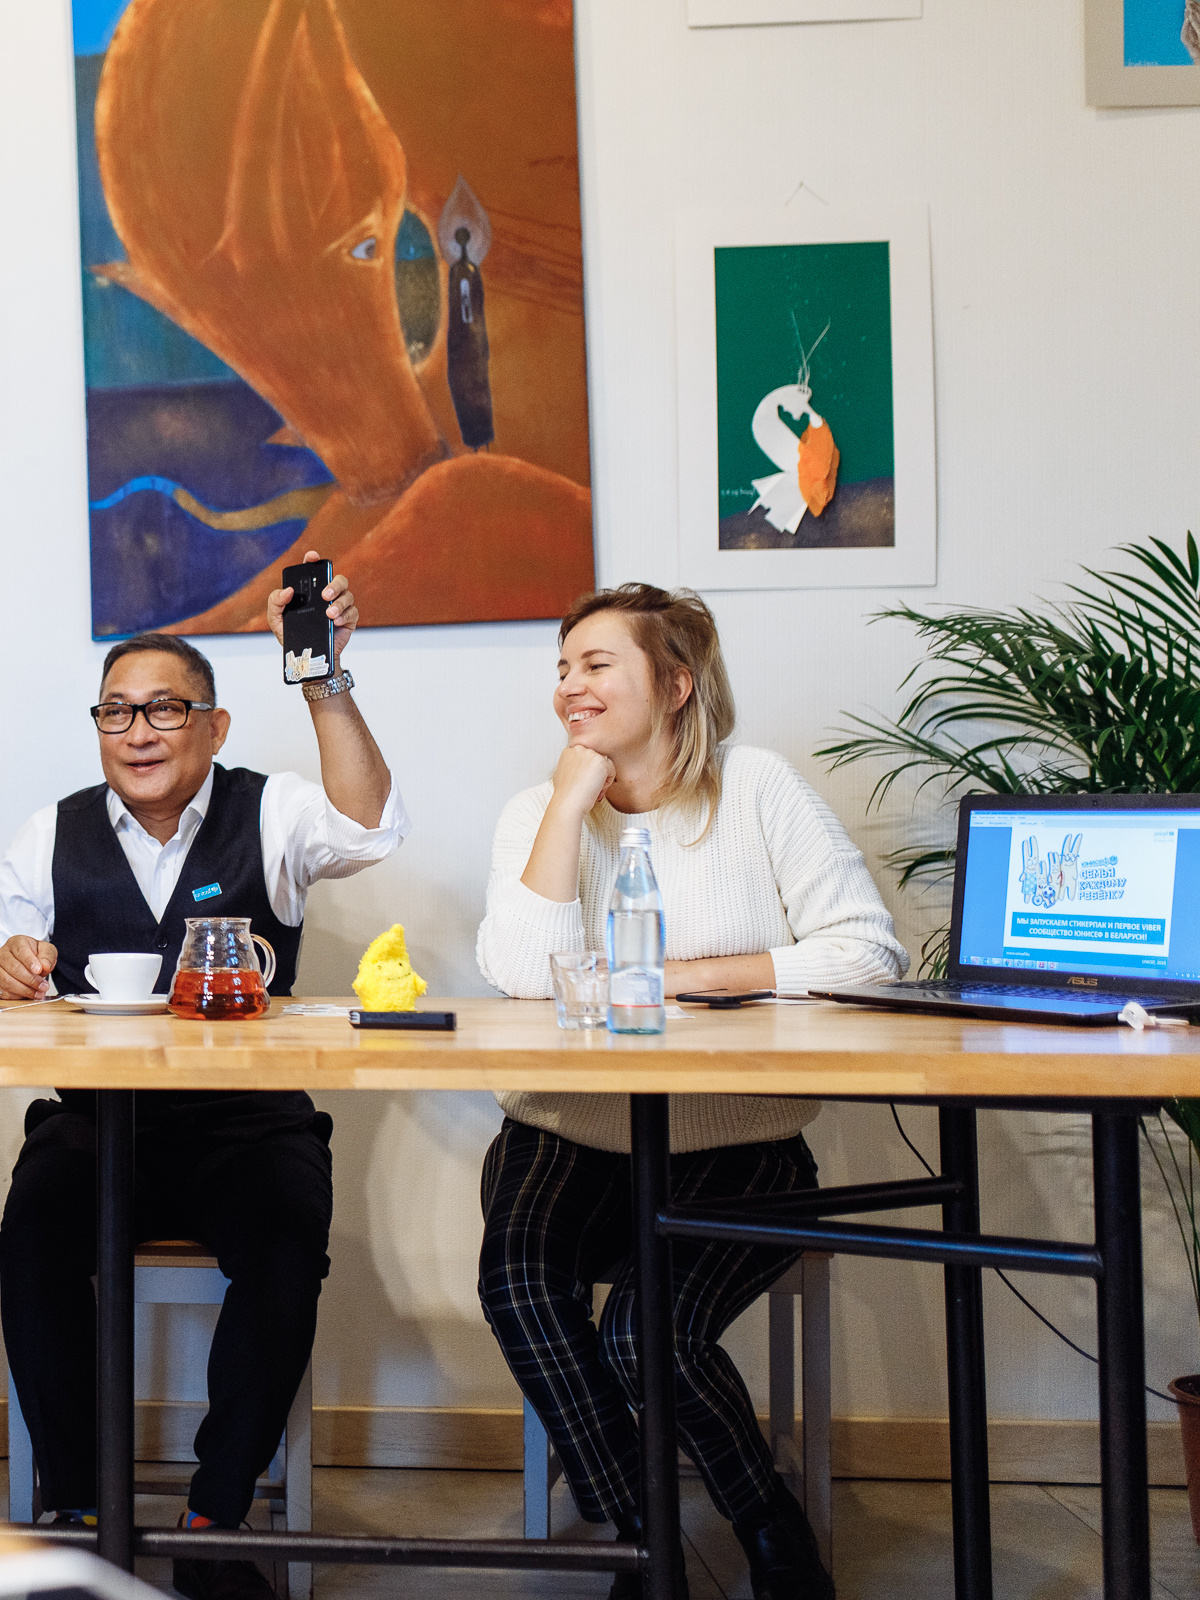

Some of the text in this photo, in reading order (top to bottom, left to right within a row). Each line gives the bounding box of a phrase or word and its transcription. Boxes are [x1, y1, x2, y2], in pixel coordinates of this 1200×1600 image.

[1080, 867, 1116, 880] СЕМЬЯ
[1078, 878, 1127, 891] КАЖДОМУ
[1016, 917, 1029, 925] МЫ
[1030, 918, 1068, 927] ЗАПУСКАЕМ
[1069, 920, 1107, 929] СТИКЕРПАК
[1114, 922, 1141, 931] ПЕРВОЕ
[1142, 923, 1161, 932] VIBER
[1029, 927, 1148, 941] СООБЩЕСТВО ЮНИСЕФ В БЕЛАРУСИ!
[1067, 976, 1098, 987] ASUS
